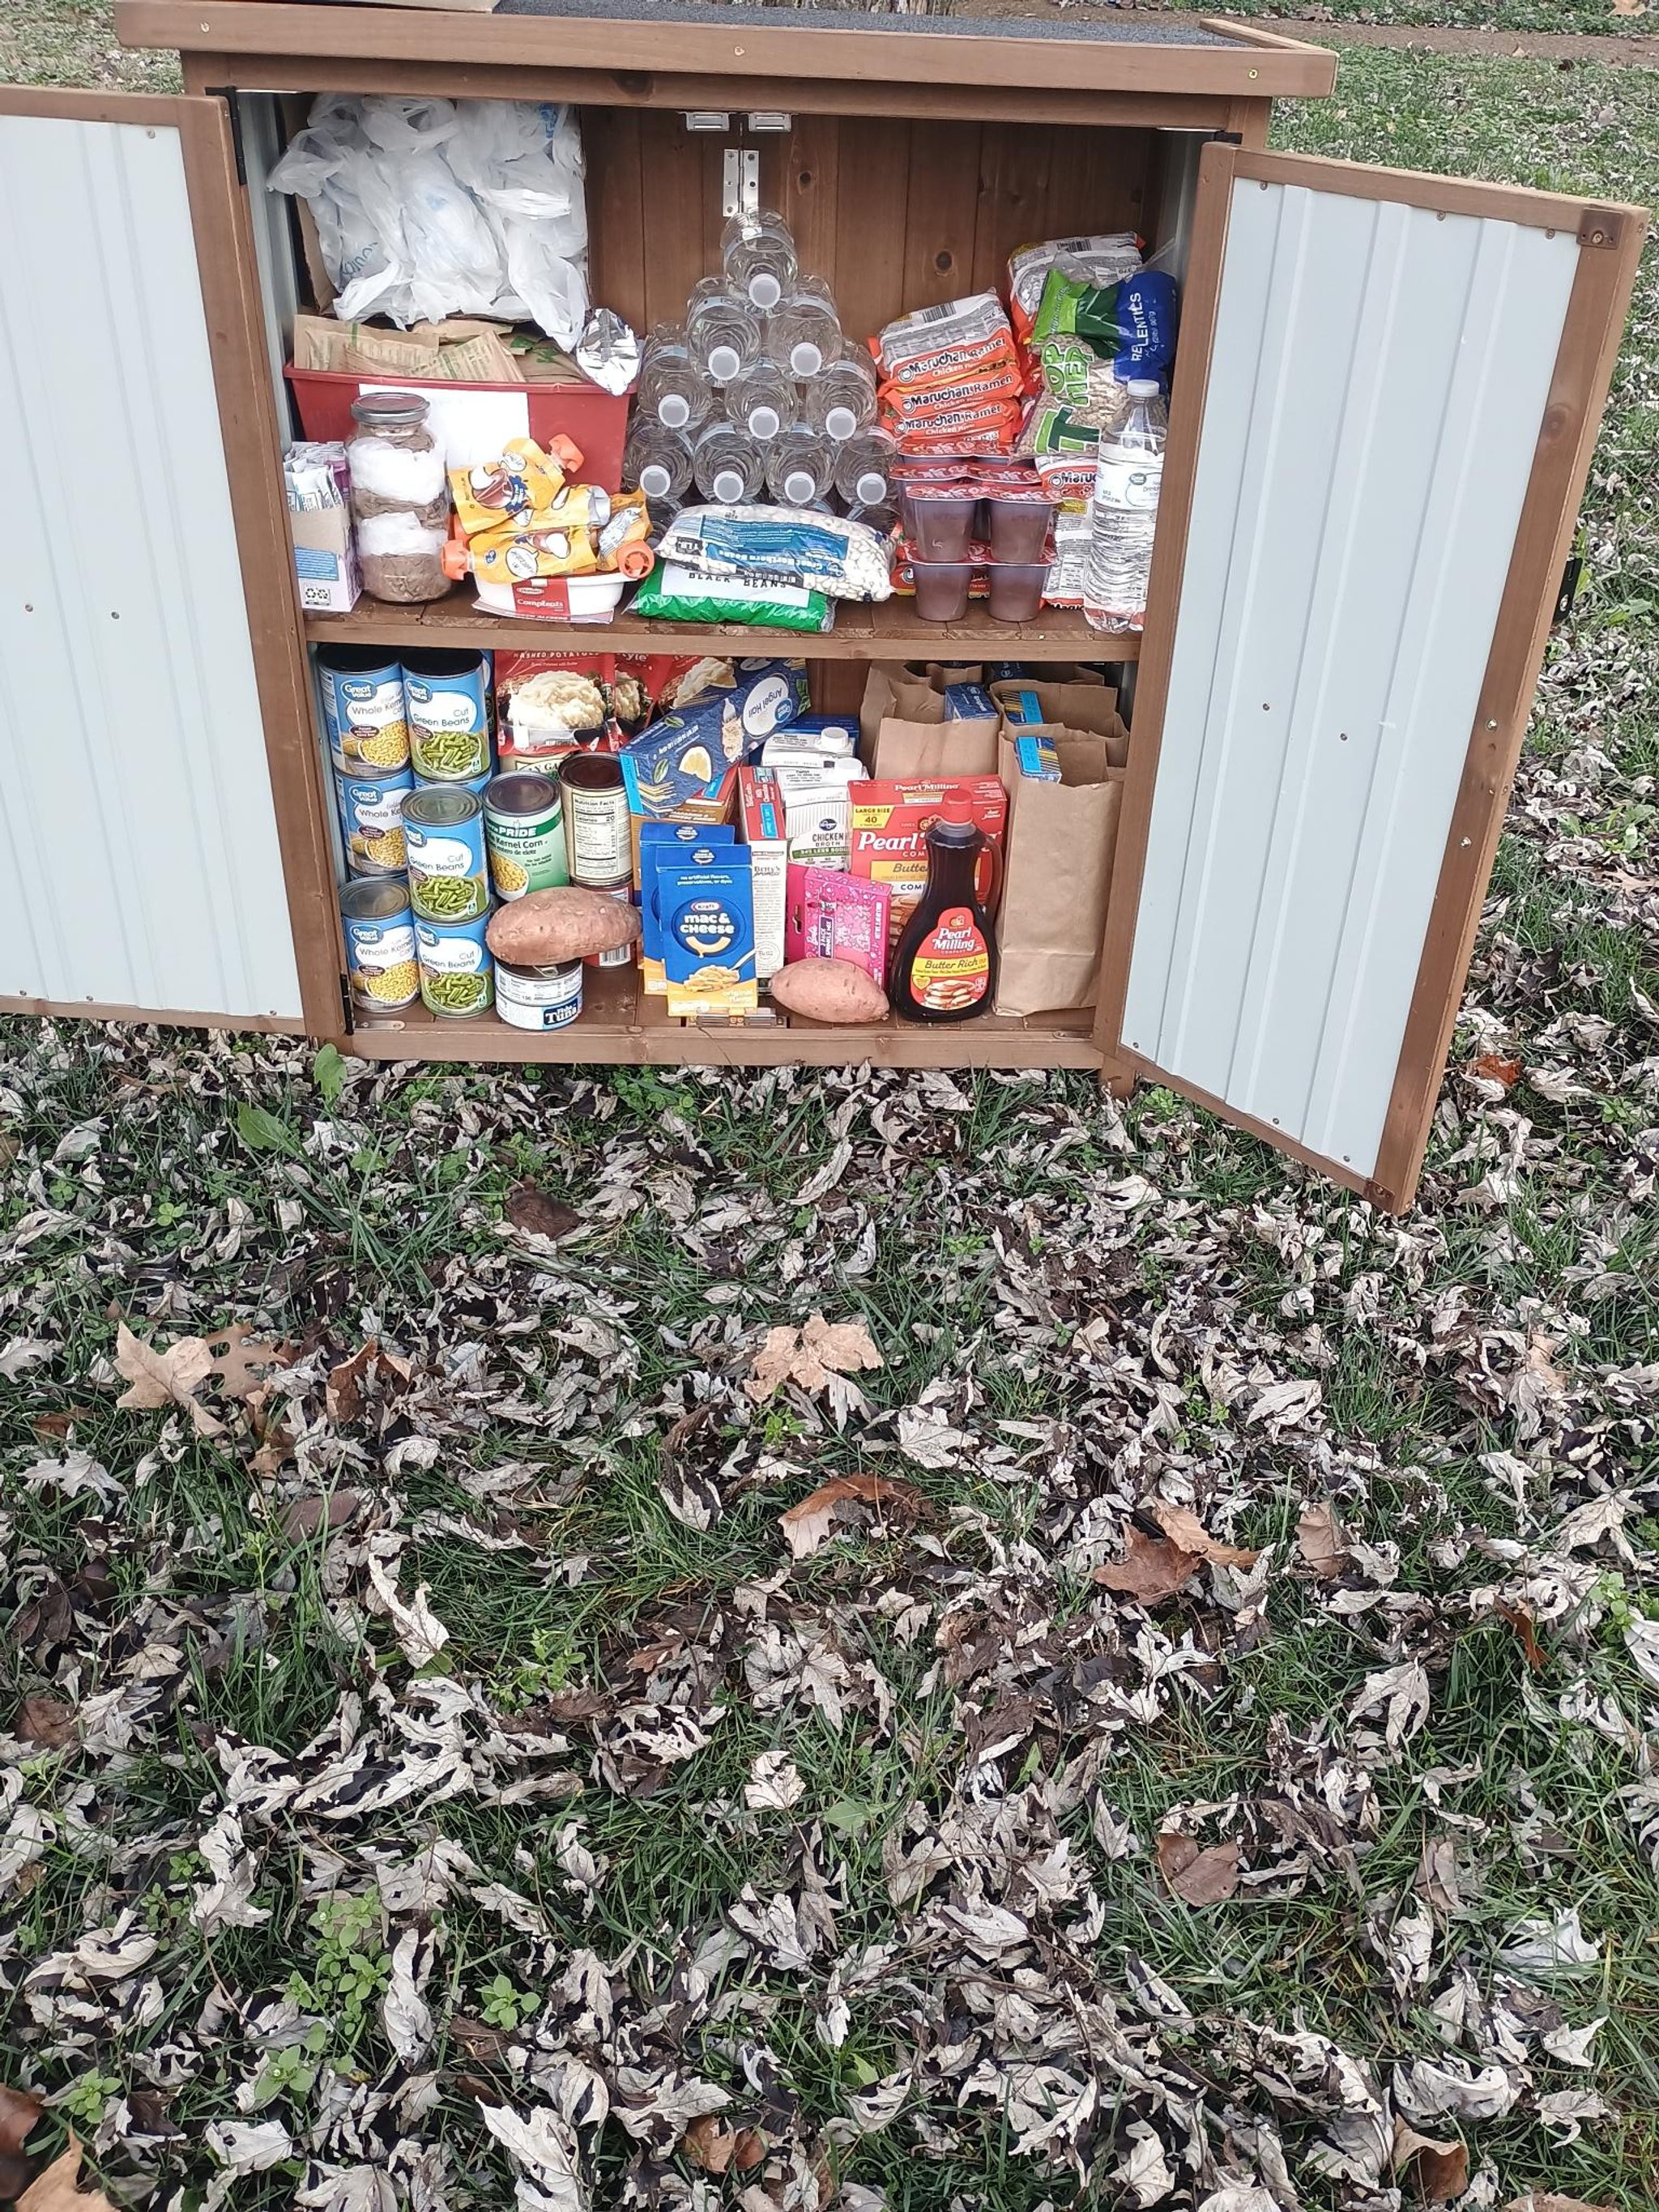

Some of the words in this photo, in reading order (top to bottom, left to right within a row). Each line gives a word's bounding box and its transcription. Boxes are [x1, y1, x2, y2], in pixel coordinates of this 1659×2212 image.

[909, 351, 968, 373] Maruchan
[932, 364, 964, 377] Chicken
[911, 385, 970, 406] Maruchan
[973, 375, 1013, 393] Ramen
[905, 412, 962, 429] Maruchan
[925, 426, 956, 436] Chicken
[1061, 471, 1097, 484] Maruc
[718, 549, 748, 561] Beans
[749, 554, 796, 567] Northern
[797, 558, 823, 570] Great
[689, 572, 731, 582] BLACK
[743, 578, 787, 589] BEANS
[517, 599, 565, 608] Compleats
[344, 684, 371, 693] Great
[762, 688, 783, 709] Angel
[352, 706, 382, 715] Whole
[454, 708, 469, 717] Cut
[413, 713, 439, 726] Green
[441, 717, 470, 727] Beans
[352, 789, 377, 799] Great
[359, 808, 389, 818] Whole
[498, 826, 537, 837] PRIDE
[812, 833, 844, 842] CHICKEN
[496, 836, 522, 849] Kernel
[522, 840, 544, 849] Corn
[858, 830, 919, 851] Pearl
[410, 856, 433, 870] Green
[436, 863, 465, 872] Beans
[447, 853, 463, 863] Cut
[893, 863, 928, 873] Butte
[684, 914, 718, 924] mac
[719, 912, 731, 924] &
[938, 927, 972, 940] Pearl
[932, 938, 975, 952] Milling
[359, 947, 389, 957] Whole
[458, 950, 475, 961] Cut
[422, 954, 446, 967] Green
[448, 959, 476, 969] Beans
[924, 960, 956, 970] Butter
[957, 957, 978, 969] Rich
